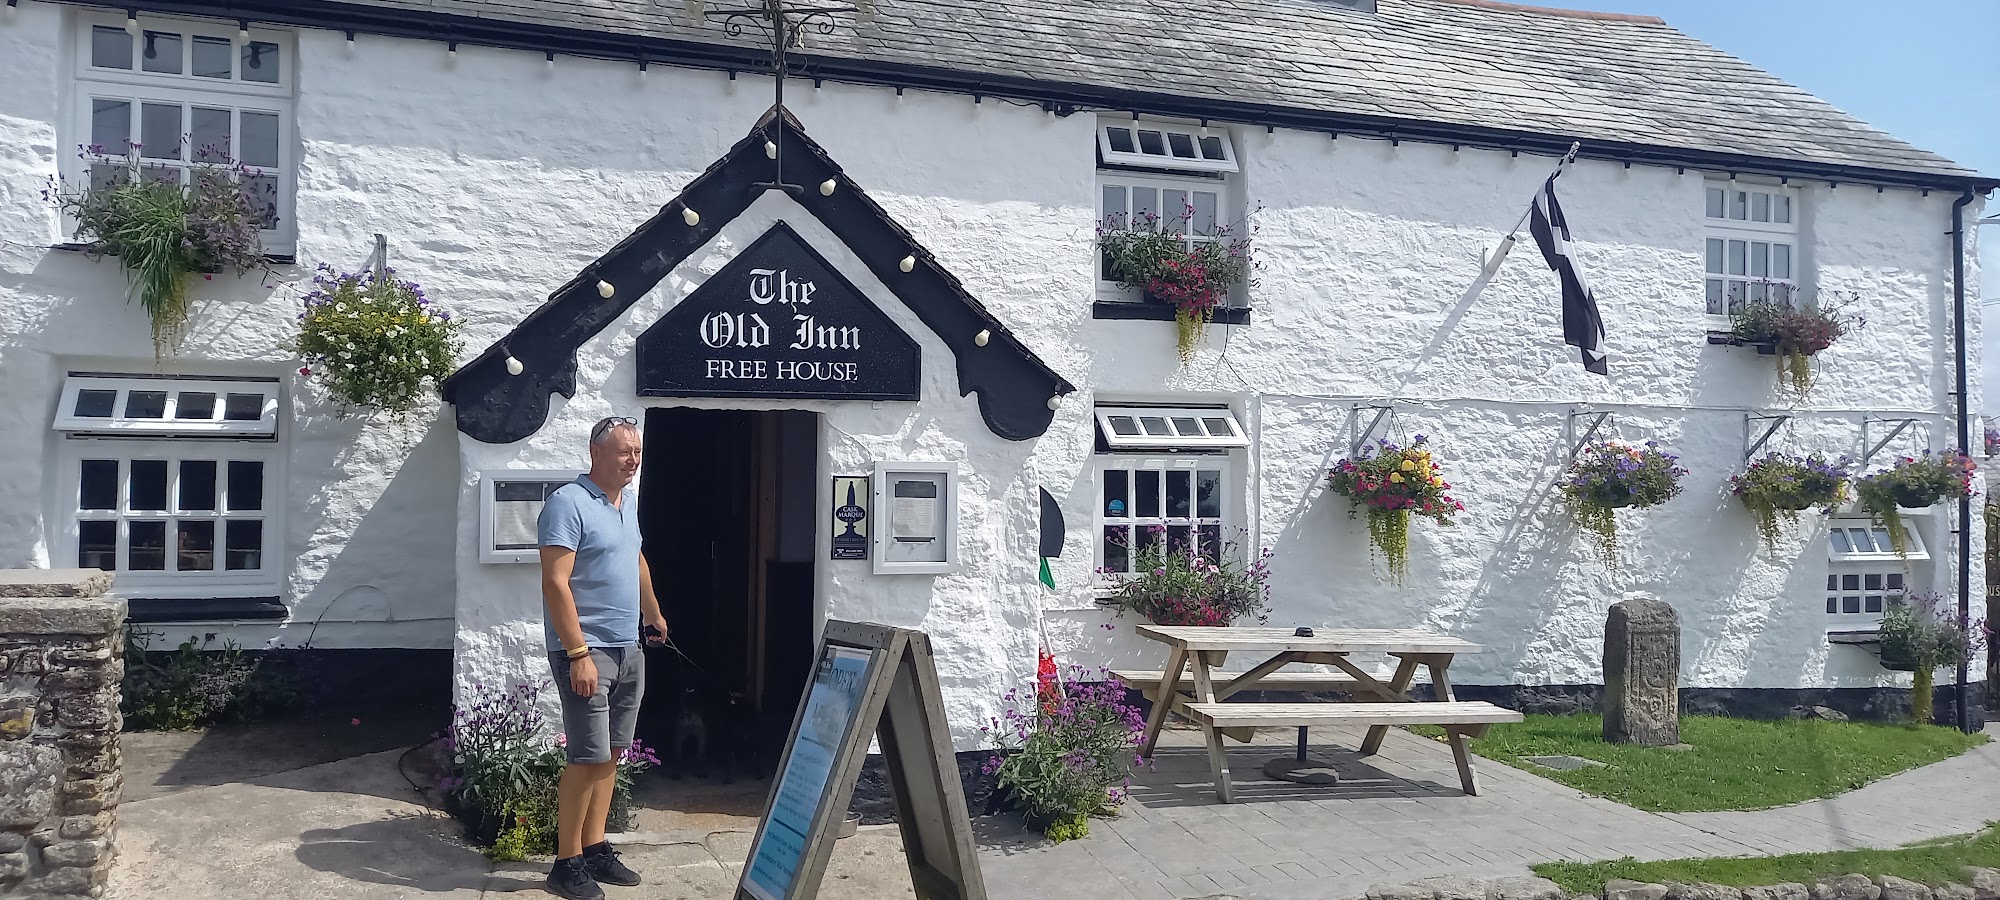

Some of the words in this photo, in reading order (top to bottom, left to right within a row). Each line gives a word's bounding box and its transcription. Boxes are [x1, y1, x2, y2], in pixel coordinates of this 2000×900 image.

[750, 268, 817, 313] The
[700, 311, 771, 349] Old
[790, 314, 862, 350] Inn
[705, 359, 768, 379] FREE
[776, 361, 859, 381] HOUSE
